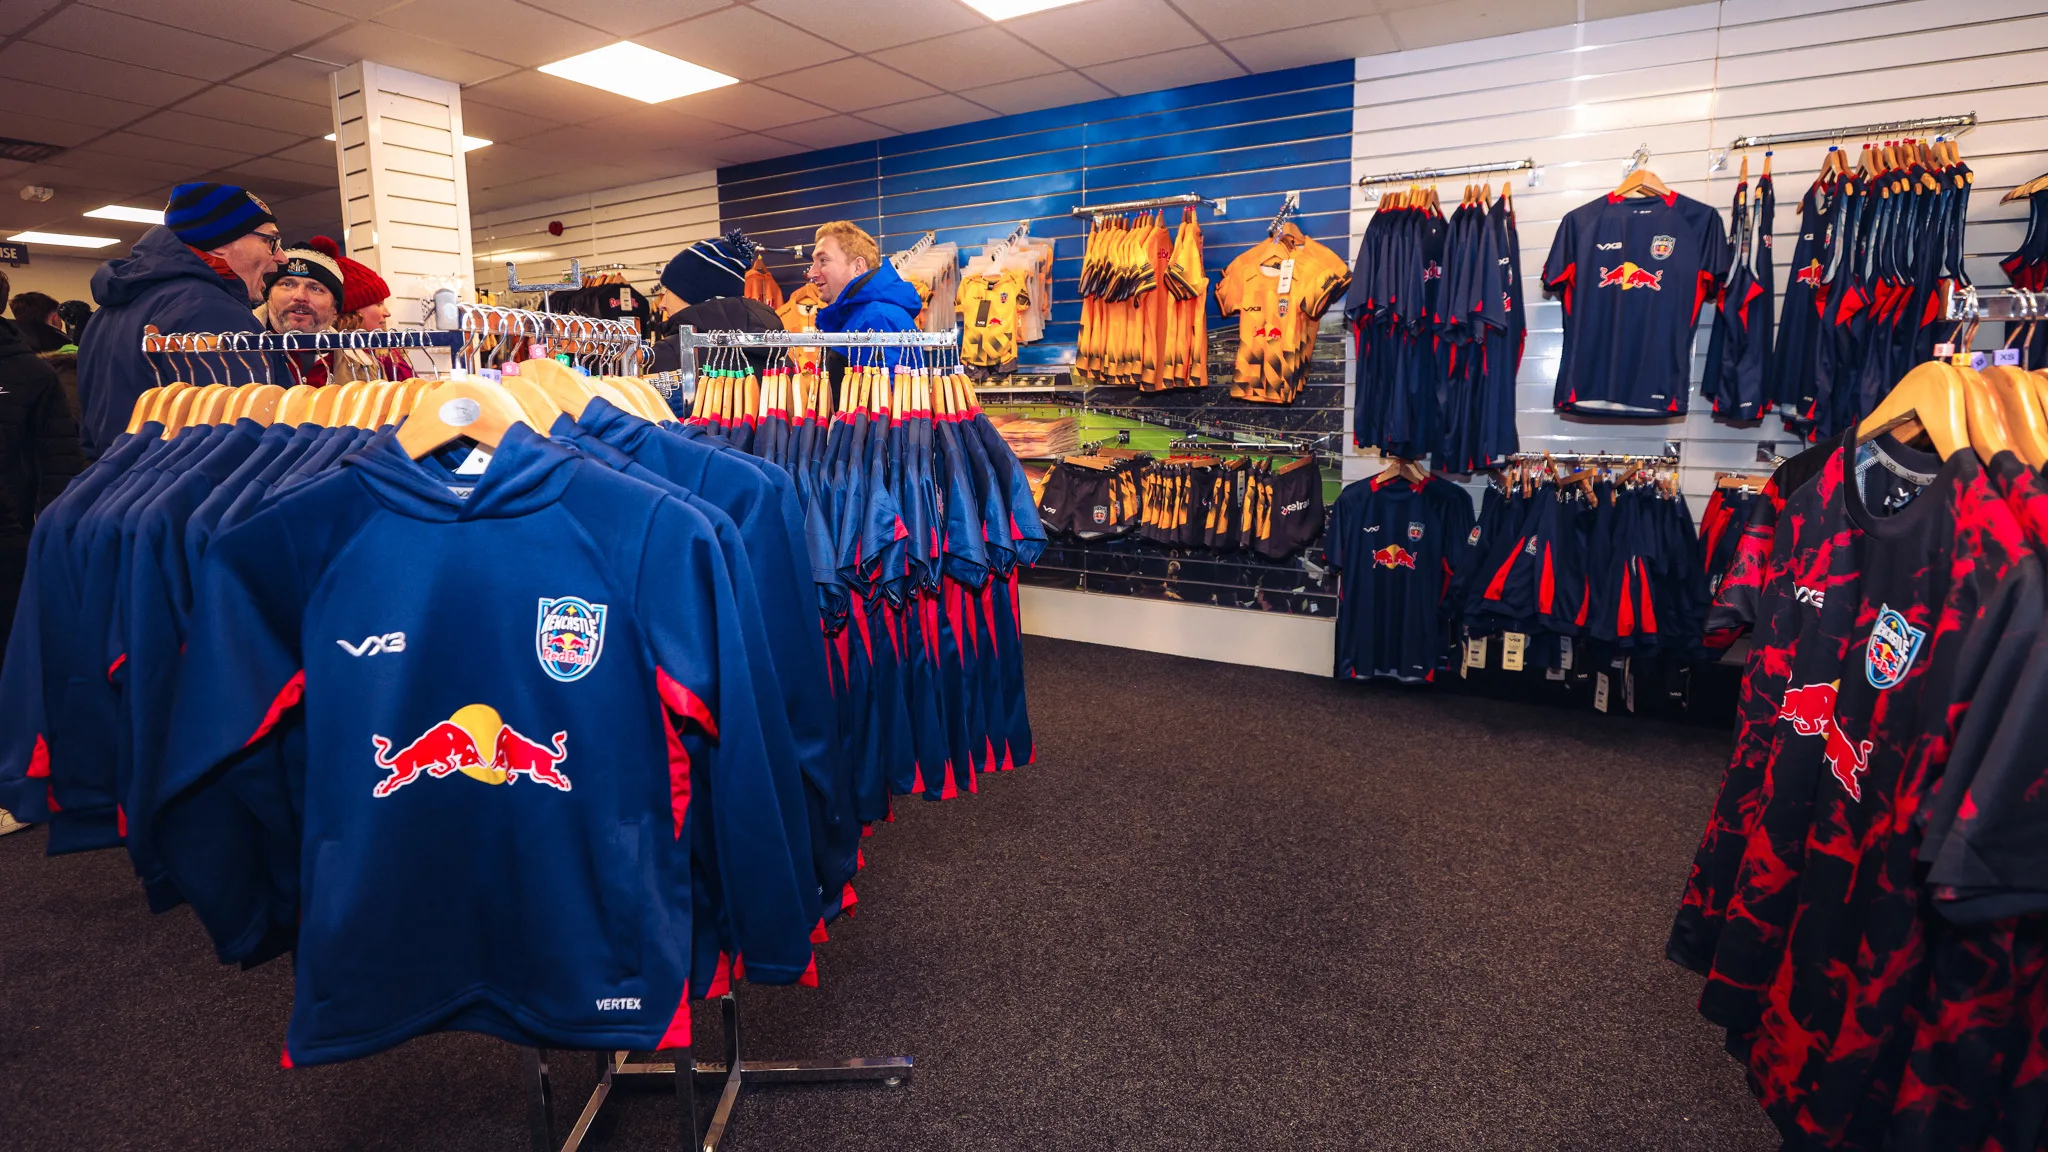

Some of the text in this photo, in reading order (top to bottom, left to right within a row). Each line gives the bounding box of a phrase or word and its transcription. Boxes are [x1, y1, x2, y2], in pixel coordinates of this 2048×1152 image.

[1596, 242, 1623, 251] VX3
[2000, 353, 2015, 361] XS
[541, 614, 599, 641] NEWCASTLE
[336, 631, 407, 657] VX3
[595, 998, 642, 1011] VERTEX
